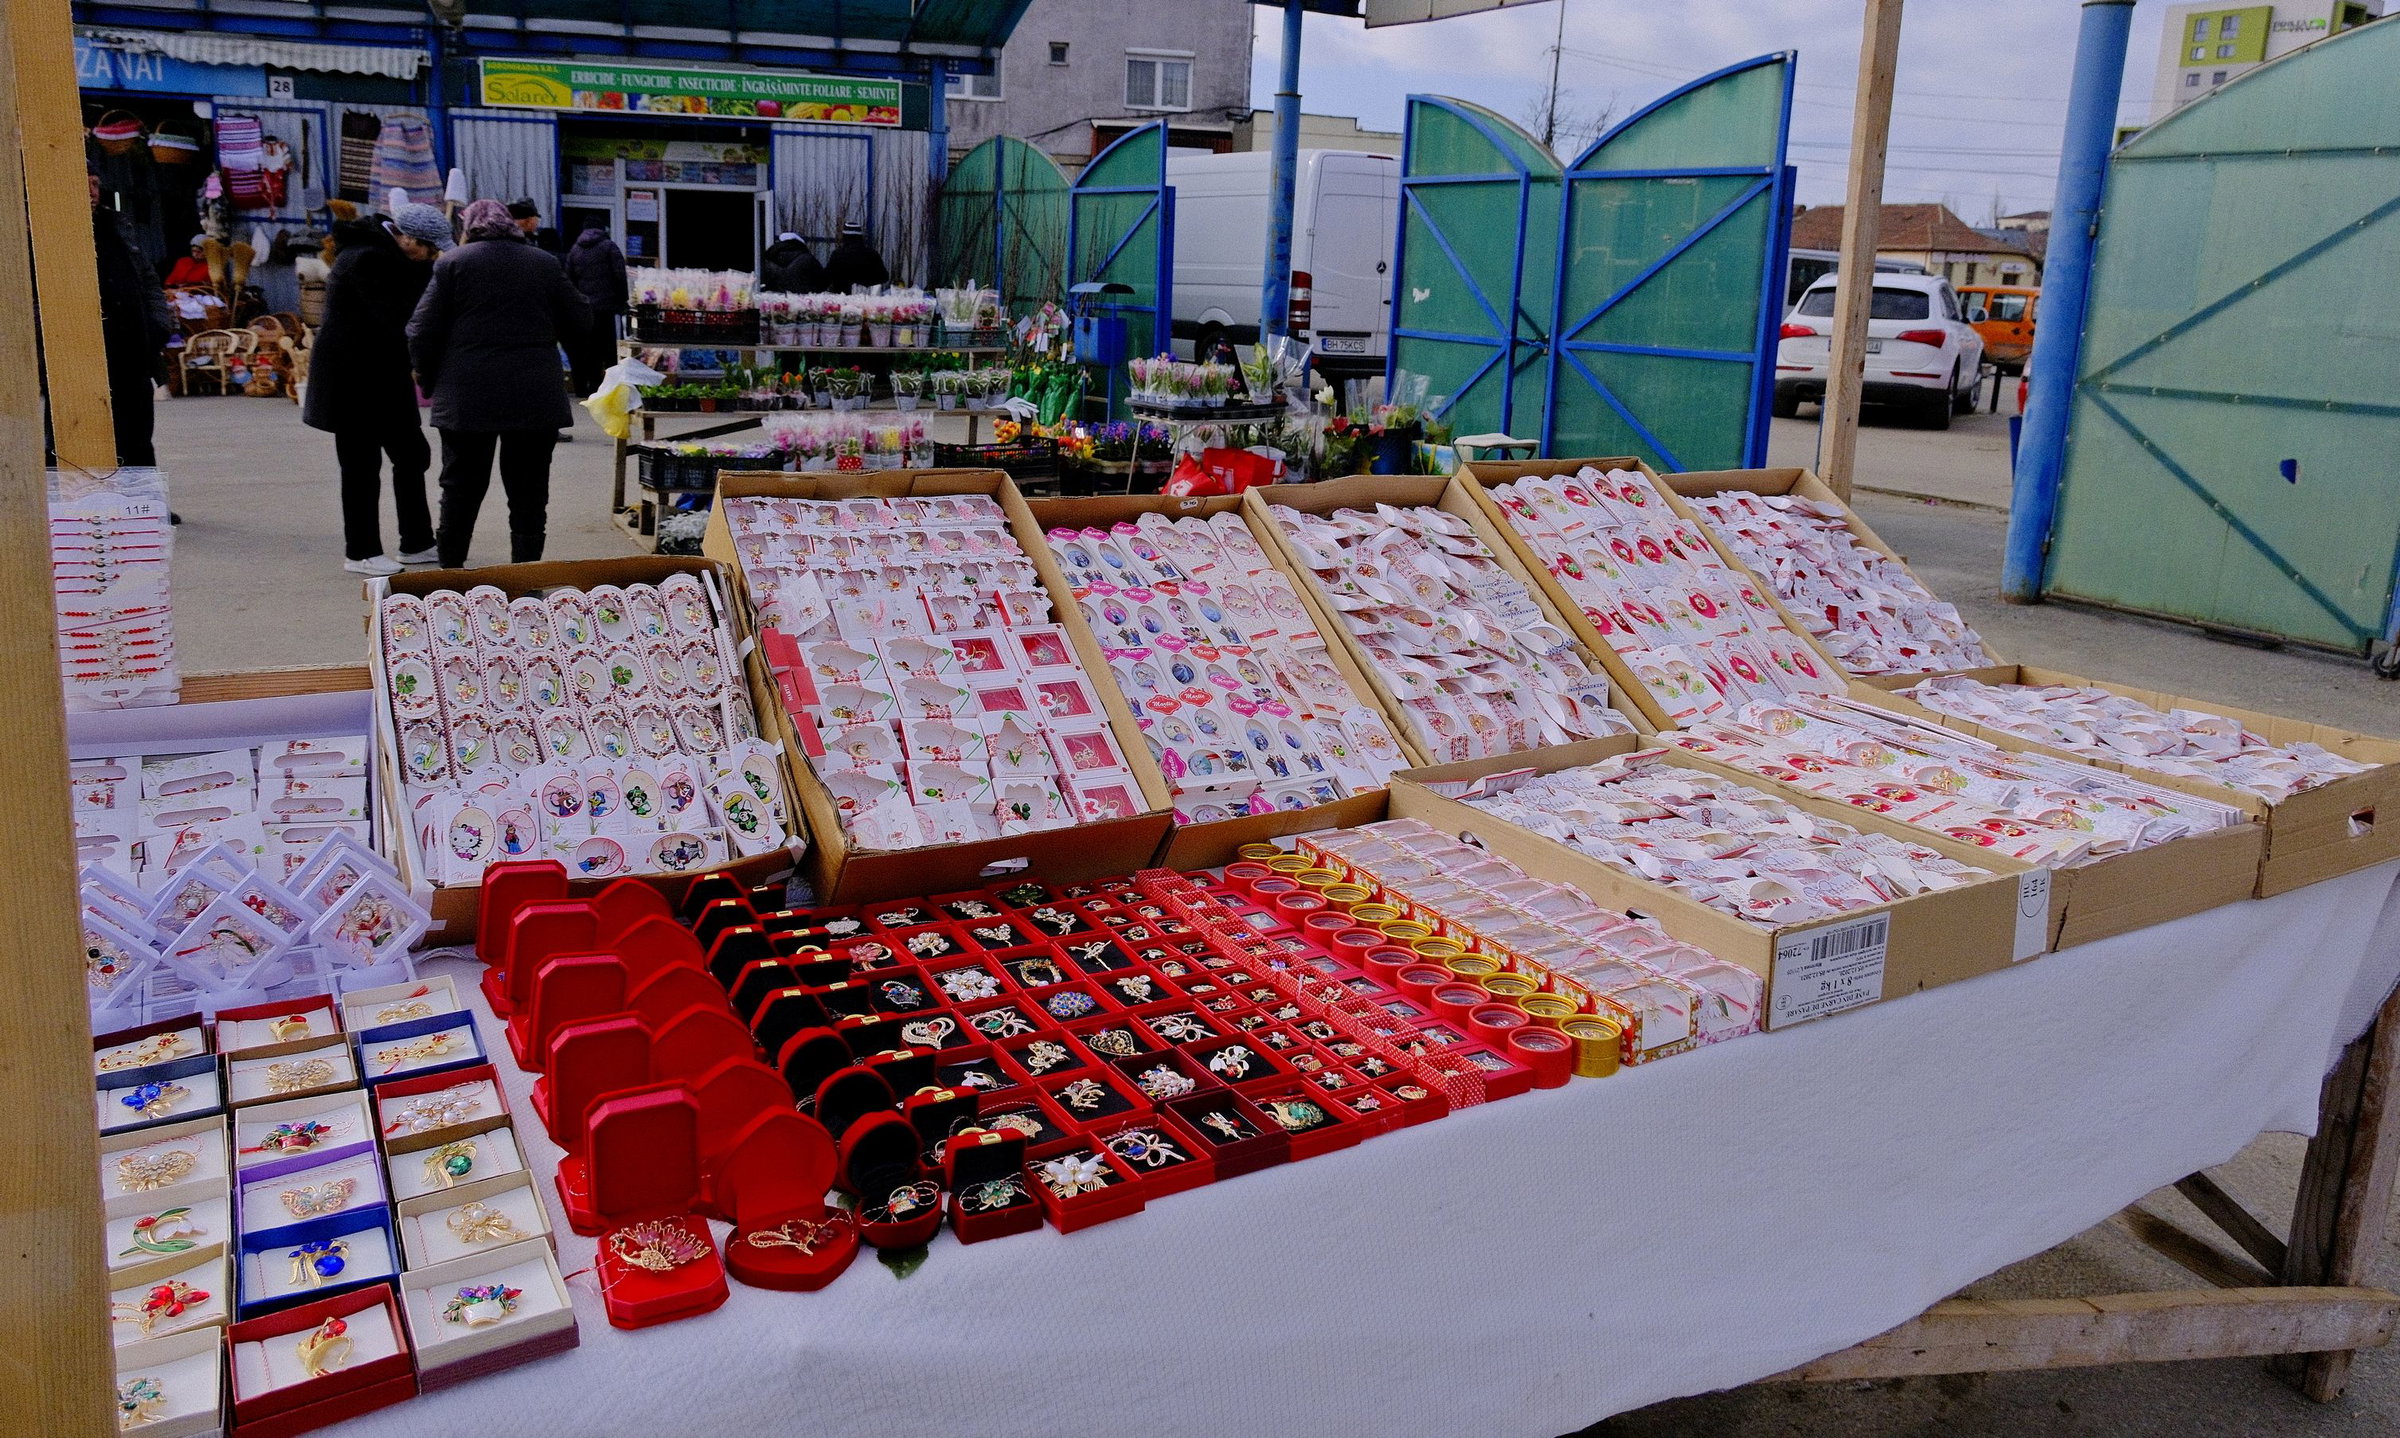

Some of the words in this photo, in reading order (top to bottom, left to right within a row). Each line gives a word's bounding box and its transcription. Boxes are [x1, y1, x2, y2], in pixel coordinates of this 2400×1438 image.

[274, 81, 290, 92] 28
[571, 70, 616, 86] ERBICIDE
[621, 73, 673, 89] FUNGICIDE
[678, 76, 737, 93] INSECTICIDE
[812, 84, 852, 99] FOLIARE
[1327, 340, 1338, 349] BH
[125, 504, 150, 515] 11#
[1820, 980, 1831, 992] kg
[1847, 976, 1853, 986] 8
